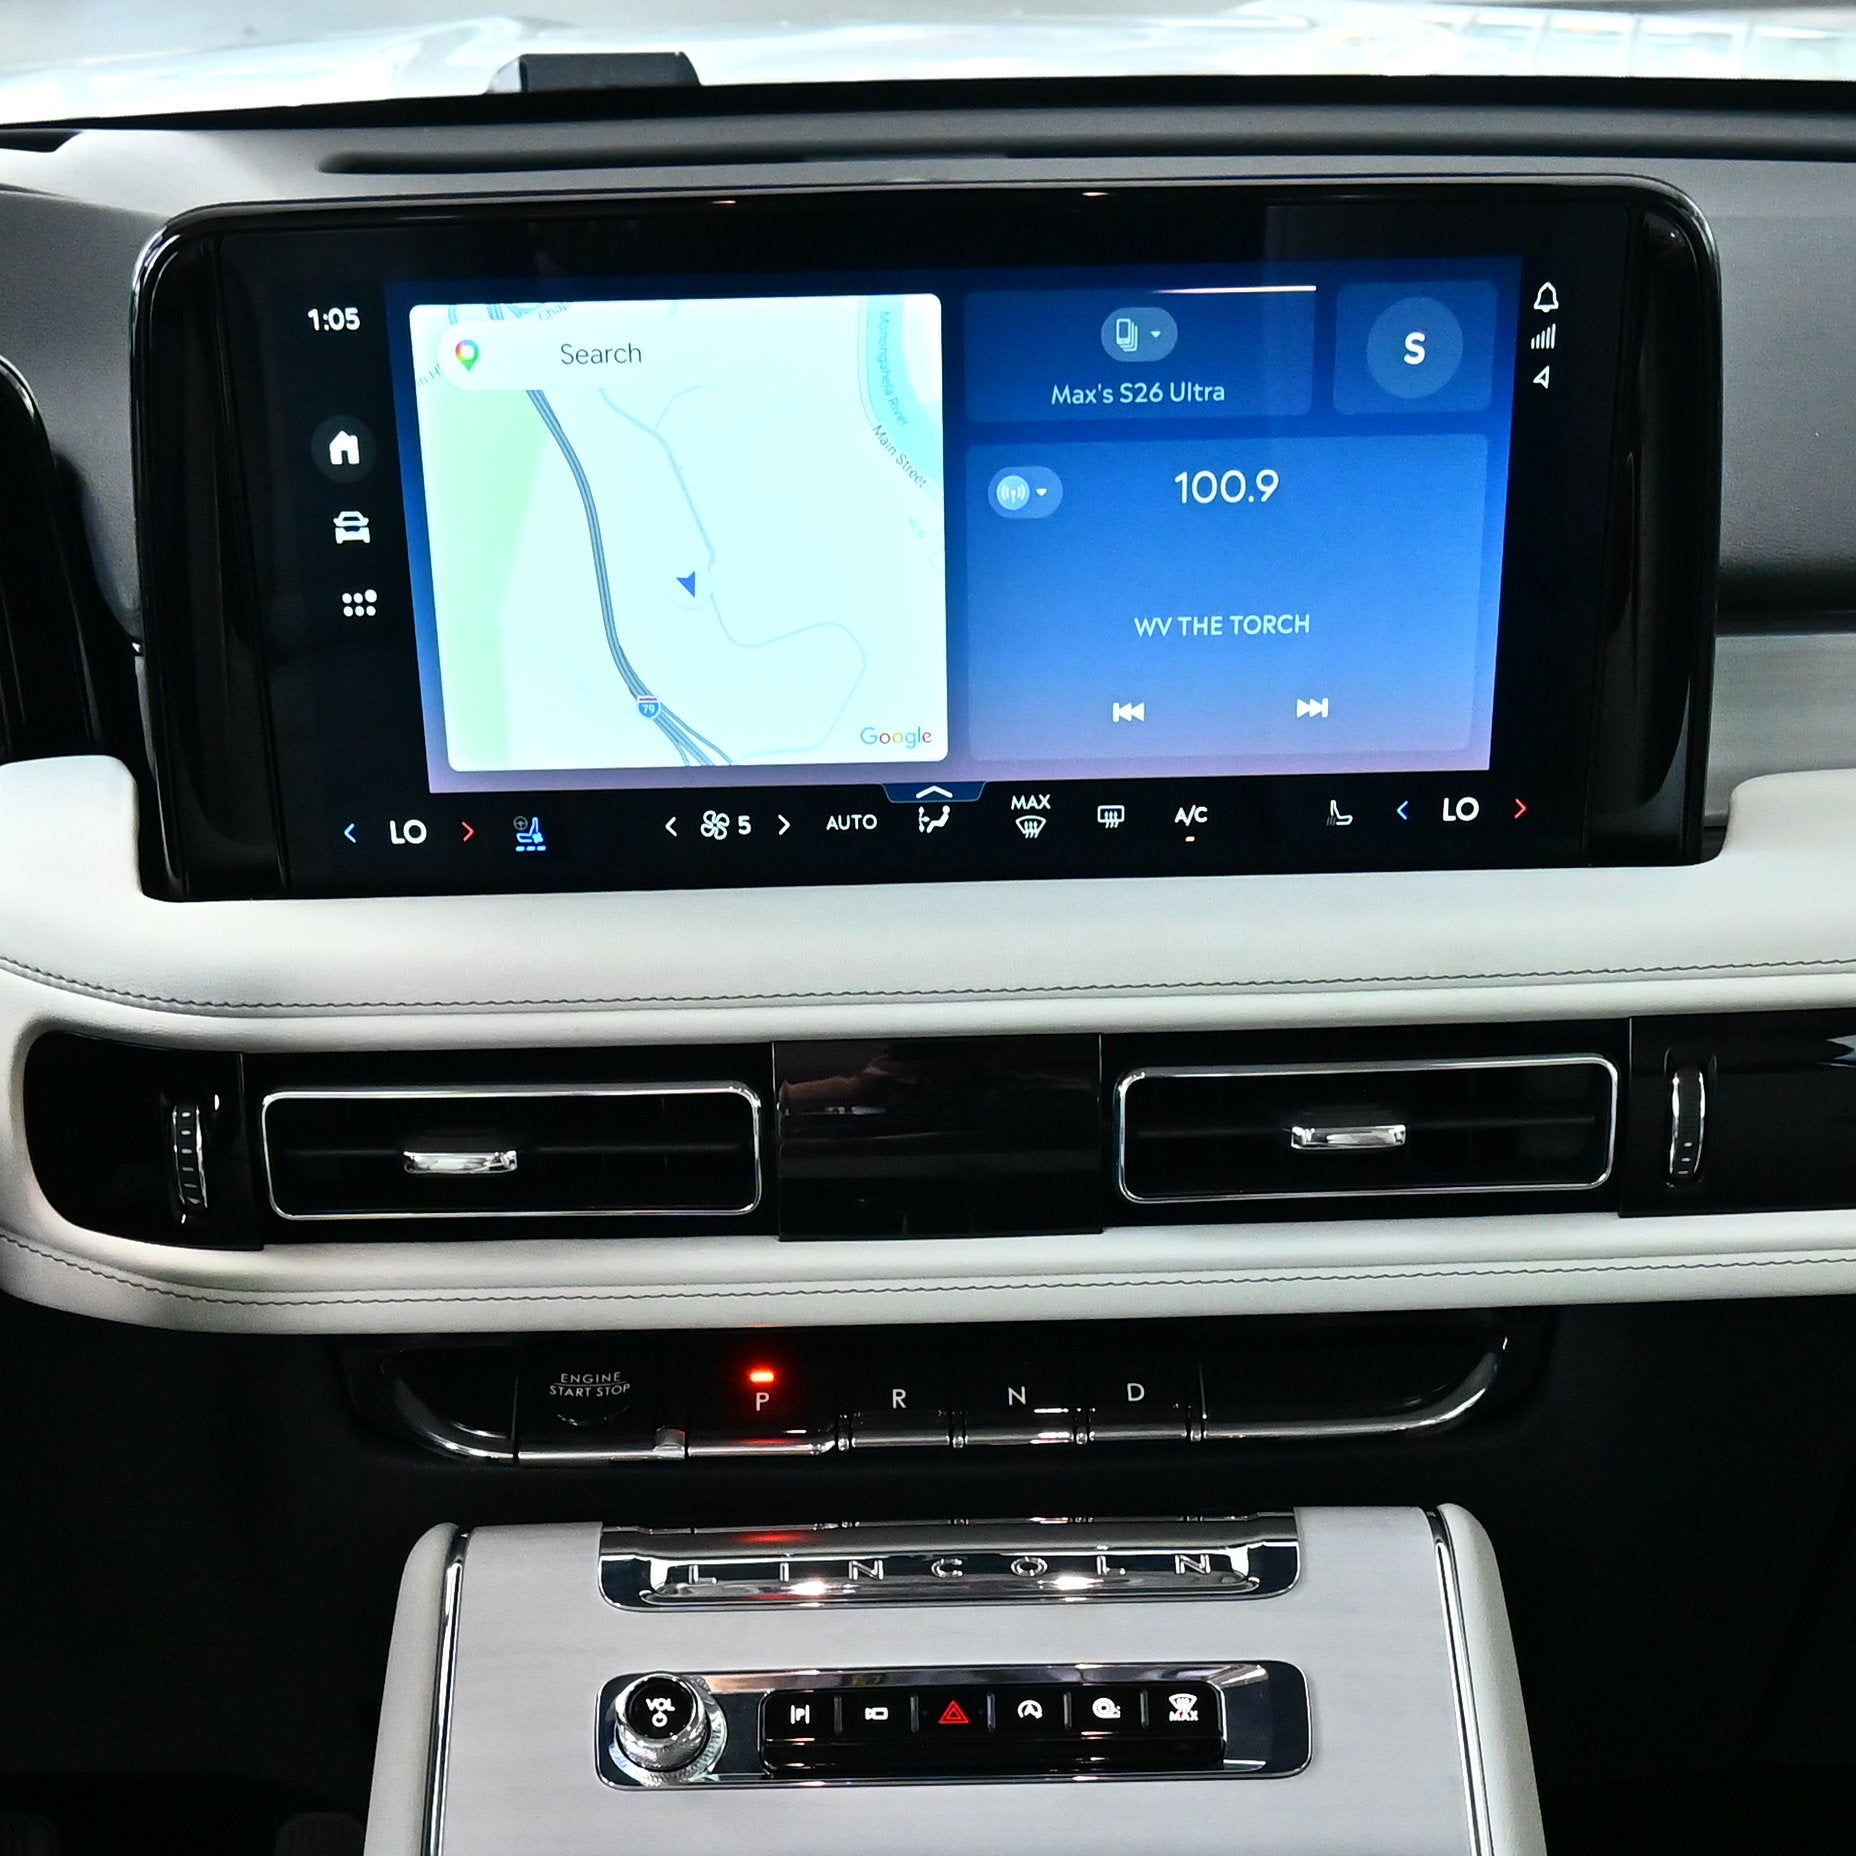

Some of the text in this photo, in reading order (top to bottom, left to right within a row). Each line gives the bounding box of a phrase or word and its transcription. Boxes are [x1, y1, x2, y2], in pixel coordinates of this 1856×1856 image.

[307, 307, 361, 331] 1:05
[560, 343, 642, 365] Search
[1403, 331, 1427, 365] S
[1050, 380, 1225, 405] Max's S26 Ultra
[887, 397, 908, 426] River
[872, 424, 927, 489] Main Street
[1174, 469, 1279, 504] 100.9
[1134, 614, 1310, 637] WV THE TORCH
[641, 703, 655, 714] 79
[859, 726, 933, 749] Google
[1011, 793, 1051, 811] MAX
[1443, 796, 1480, 822] LO
[737, 815, 752, 836] 5
[825, 813, 878, 832] AUTO
[1174, 806, 1208, 826] A/C
[390, 819, 427, 845] LO
[560, 1371, 621, 1384] ENGINE
[549, 1383, 631, 1397] START STOP
[892, 1389, 907, 1408] R
[1008, 1386, 1027, 1406] N
[1127, 1383, 1145, 1402] D
[755, 1392, 770, 1411] P
[688, 1554, 1211, 1583] LINCOLN
[646, 1697, 676, 1712] VOL
[1169, 1710, 1199, 1722] MAX
